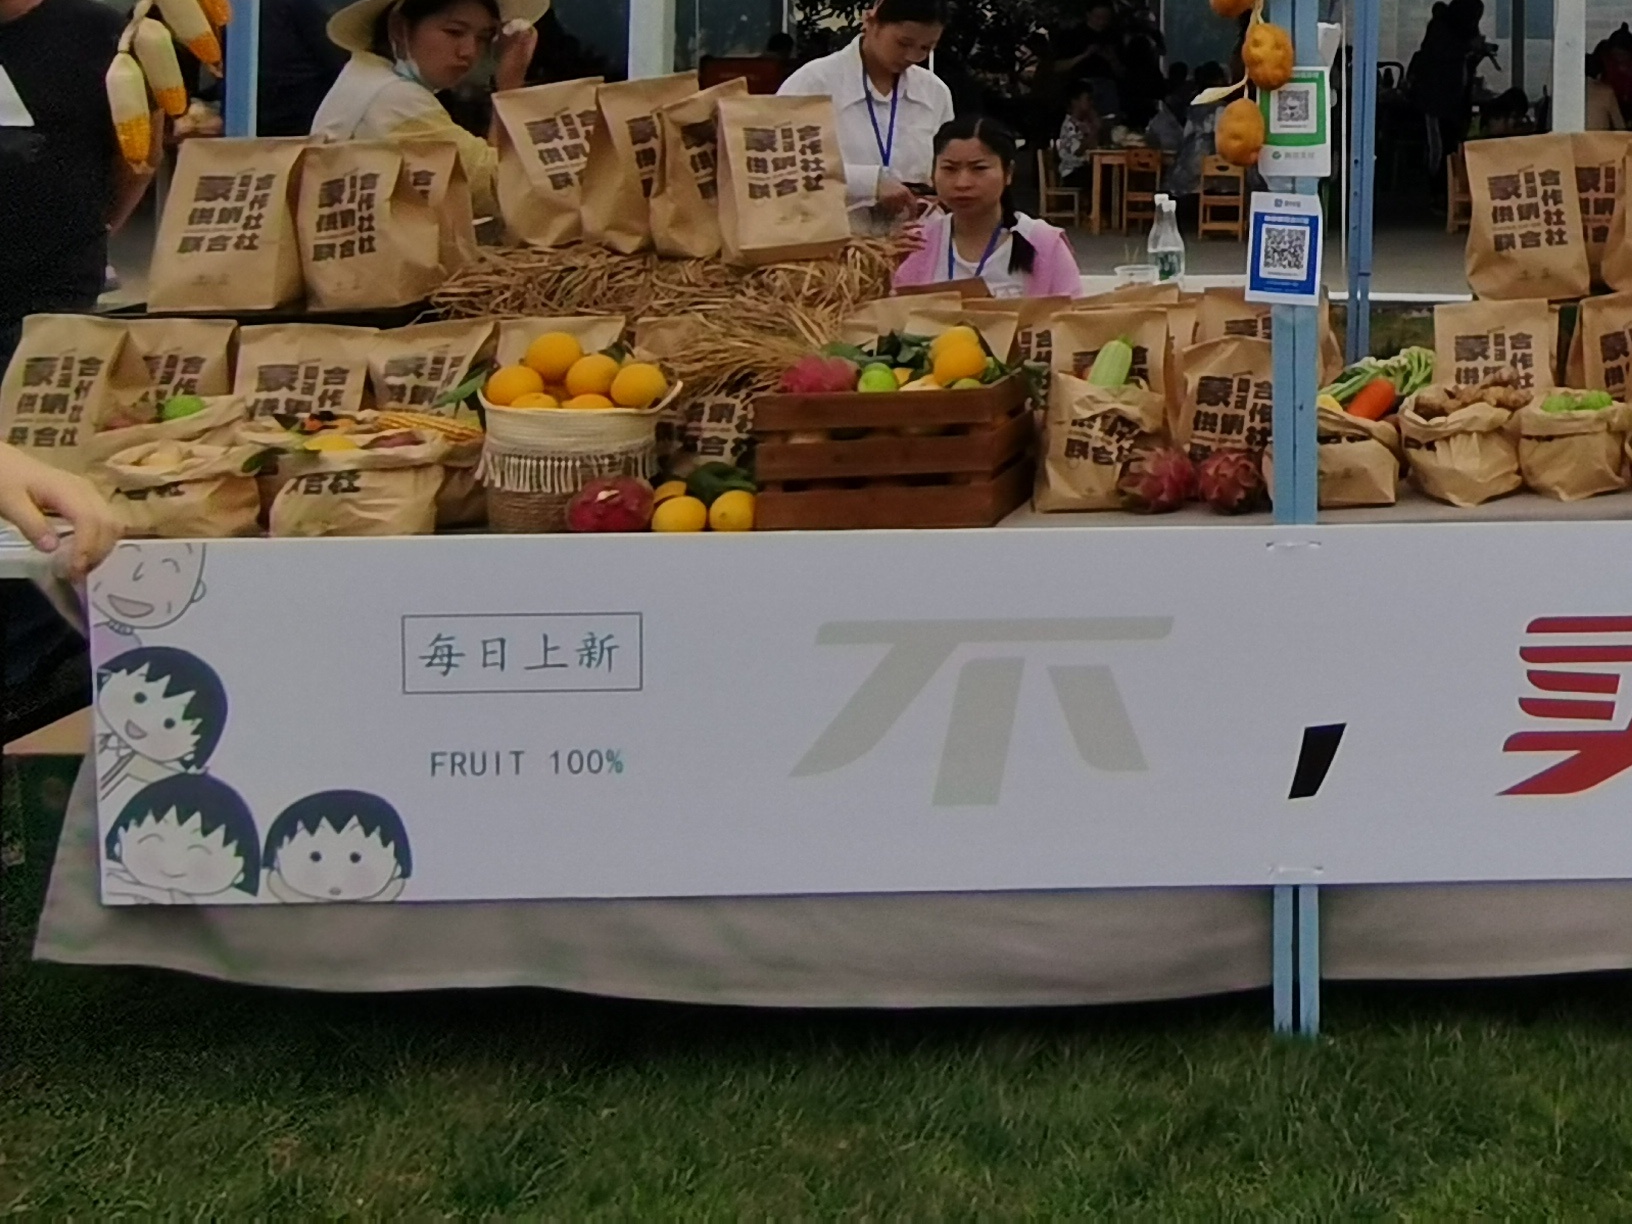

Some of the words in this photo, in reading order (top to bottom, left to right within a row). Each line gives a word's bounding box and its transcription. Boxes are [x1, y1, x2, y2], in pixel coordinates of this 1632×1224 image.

[419, 631, 620, 677] 每日上新
[430, 750, 525, 777] FRUIT
[550, 749, 624, 775] 100%
